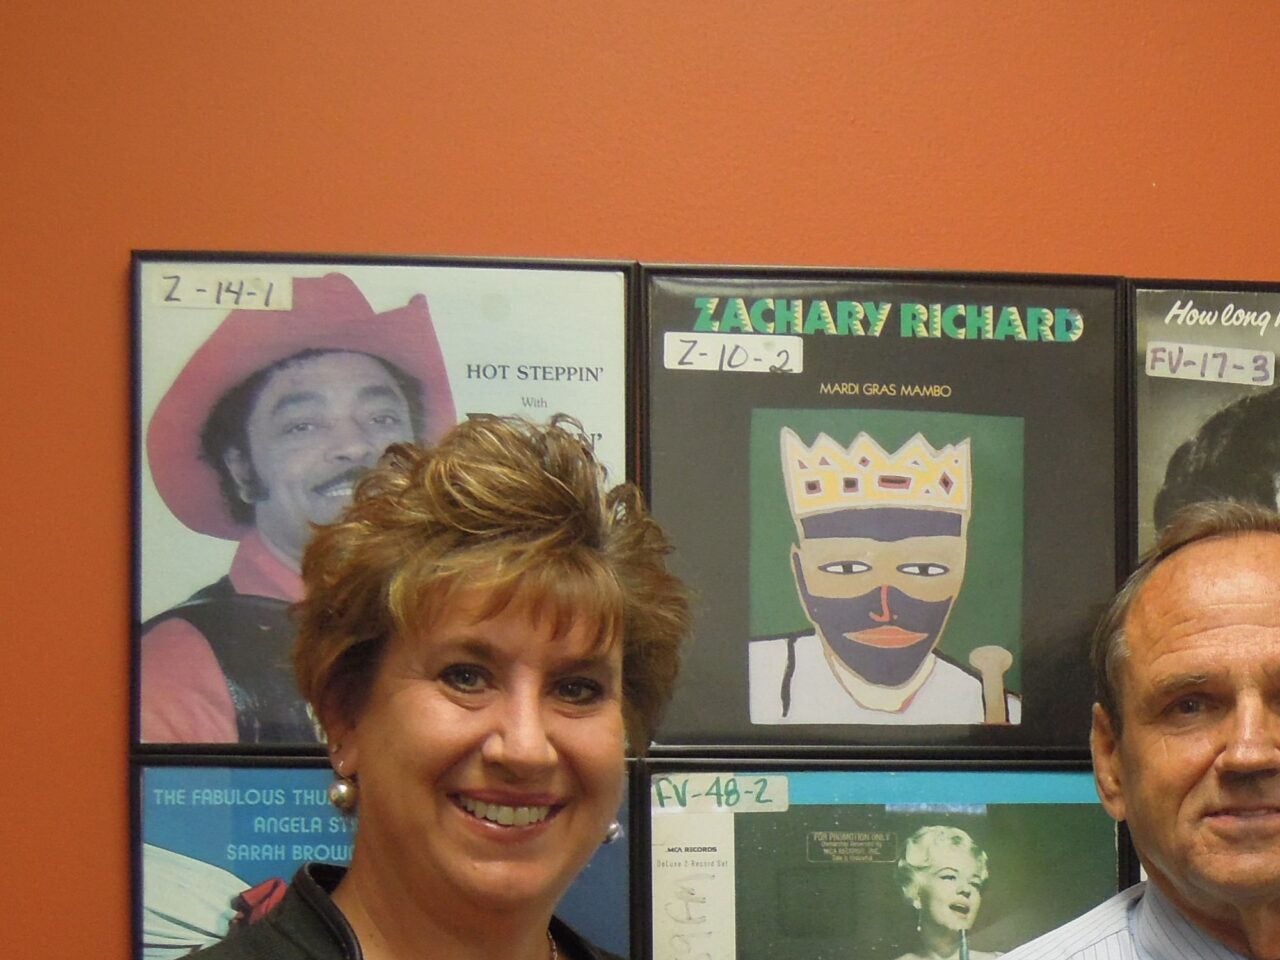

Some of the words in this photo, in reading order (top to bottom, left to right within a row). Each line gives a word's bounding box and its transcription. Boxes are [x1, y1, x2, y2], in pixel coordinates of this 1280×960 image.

[693, 297, 891, 337] ZACHARY
[900, 303, 1085, 342] RICHARD
[1164, 300, 1218, 326] How
[1221, 303, 1271, 336] long
[677, 339, 794, 374] Z-10-2
[1149, 346, 1271, 382] FV-17-3
[466, 363, 510, 380] HOT
[516, 365, 604, 382] STEPPIN'
[819, 383, 860, 396] MARDI
[862, 383, 896, 397] GRAS
[900, 384, 952, 398] MAMBO
[521, 397, 548, 409] With
[153, 789, 186, 805] THE
[192, 789, 285, 805] FABULOUS
[292, 789, 331, 805] THU
[654, 776, 773, 808] FV-48-2
[253, 816, 323, 833] ANGELA
[227, 844, 285, 861] SARAH
